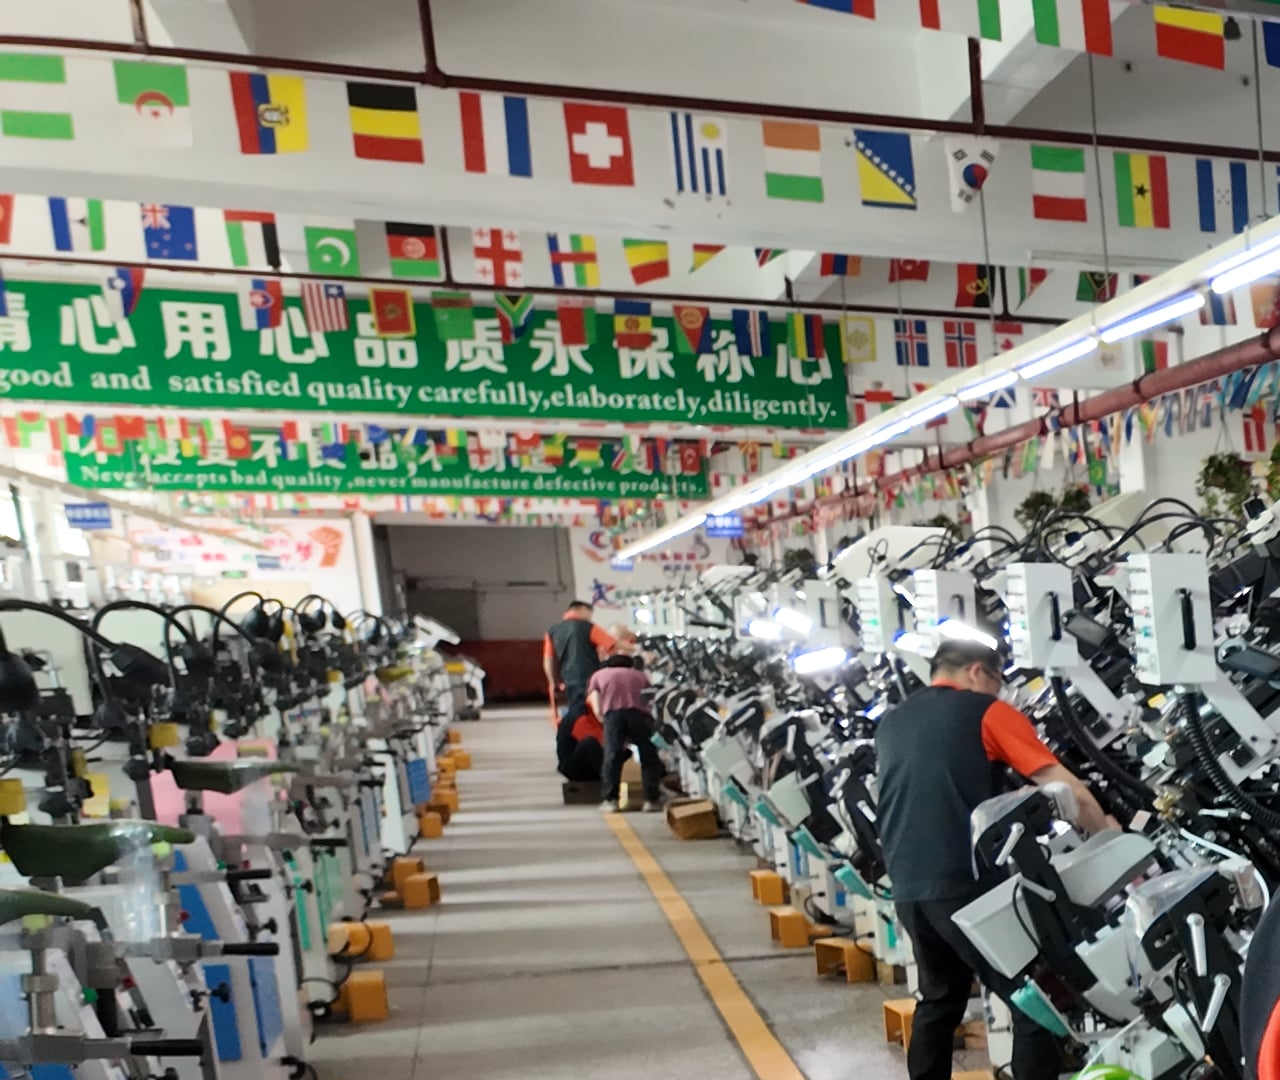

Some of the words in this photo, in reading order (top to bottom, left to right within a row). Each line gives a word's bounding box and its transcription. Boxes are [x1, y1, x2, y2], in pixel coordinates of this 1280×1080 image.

[90, 366, 152, 391] and
[168, 369, 301, 397] satisfied
[306, 375, 412, 409] quality
[231, 470, 269, 486] bad
[271, 472, 343, 491] quality
[411, 474, 530, 490] manufacture
[533, 476, 617, 492] defective
